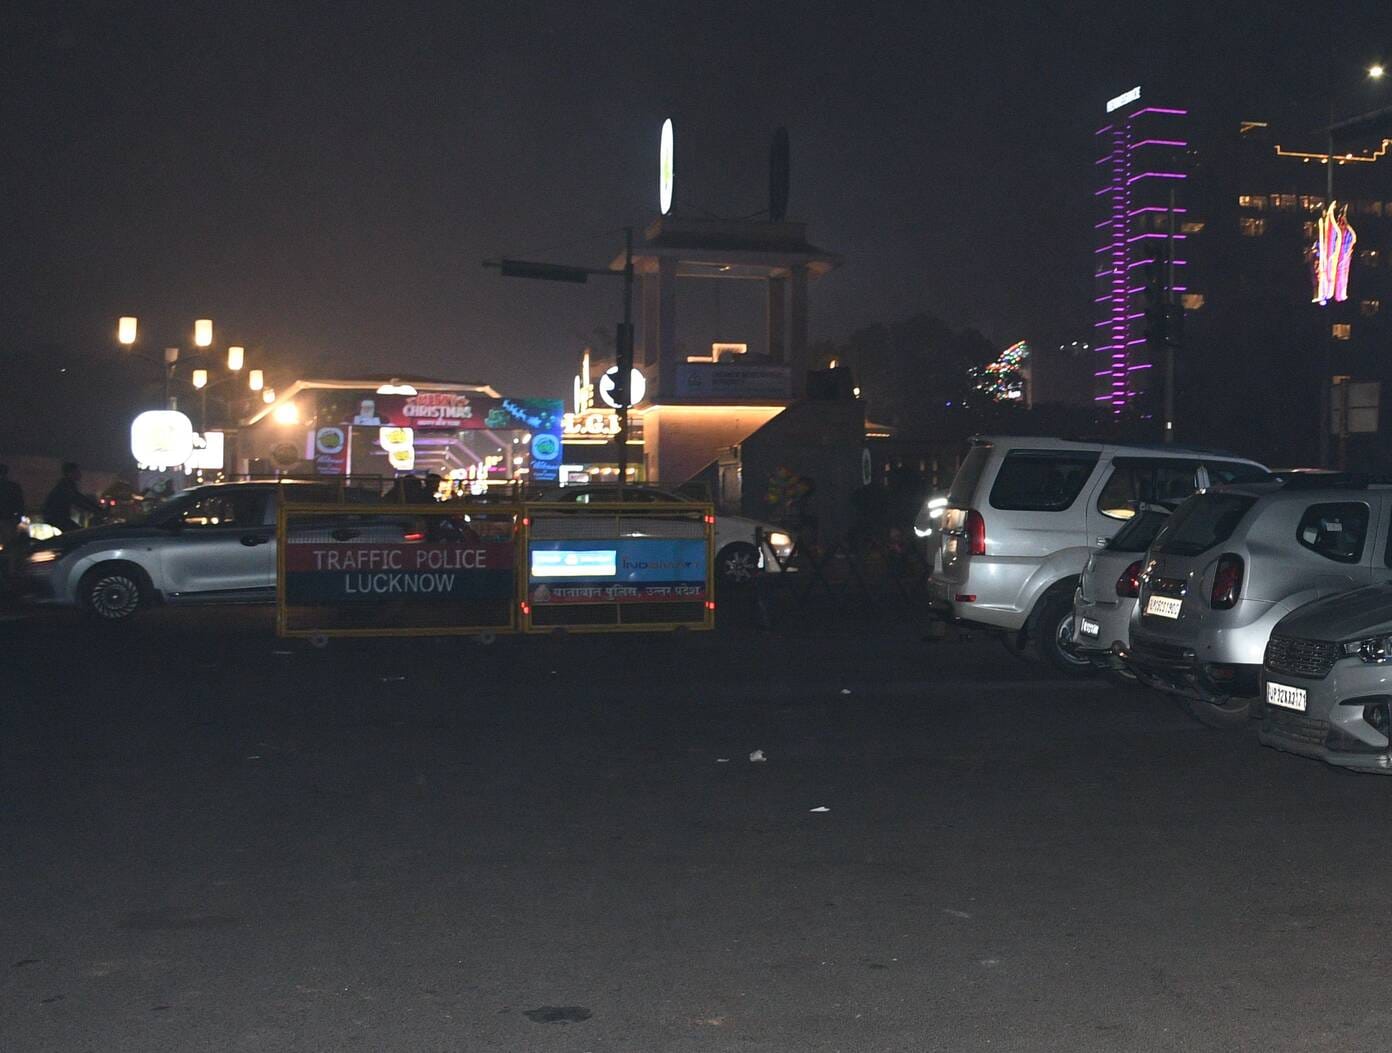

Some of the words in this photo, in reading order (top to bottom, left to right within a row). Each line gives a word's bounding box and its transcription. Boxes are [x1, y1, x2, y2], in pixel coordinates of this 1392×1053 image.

[402, 405, 472, 419] CHRISTMAS
[313, 550, 402, 569] TRAFFIC
[417, 549, 486, 569] POLICE
[346, 573, 455, 593] LUCKNOW
